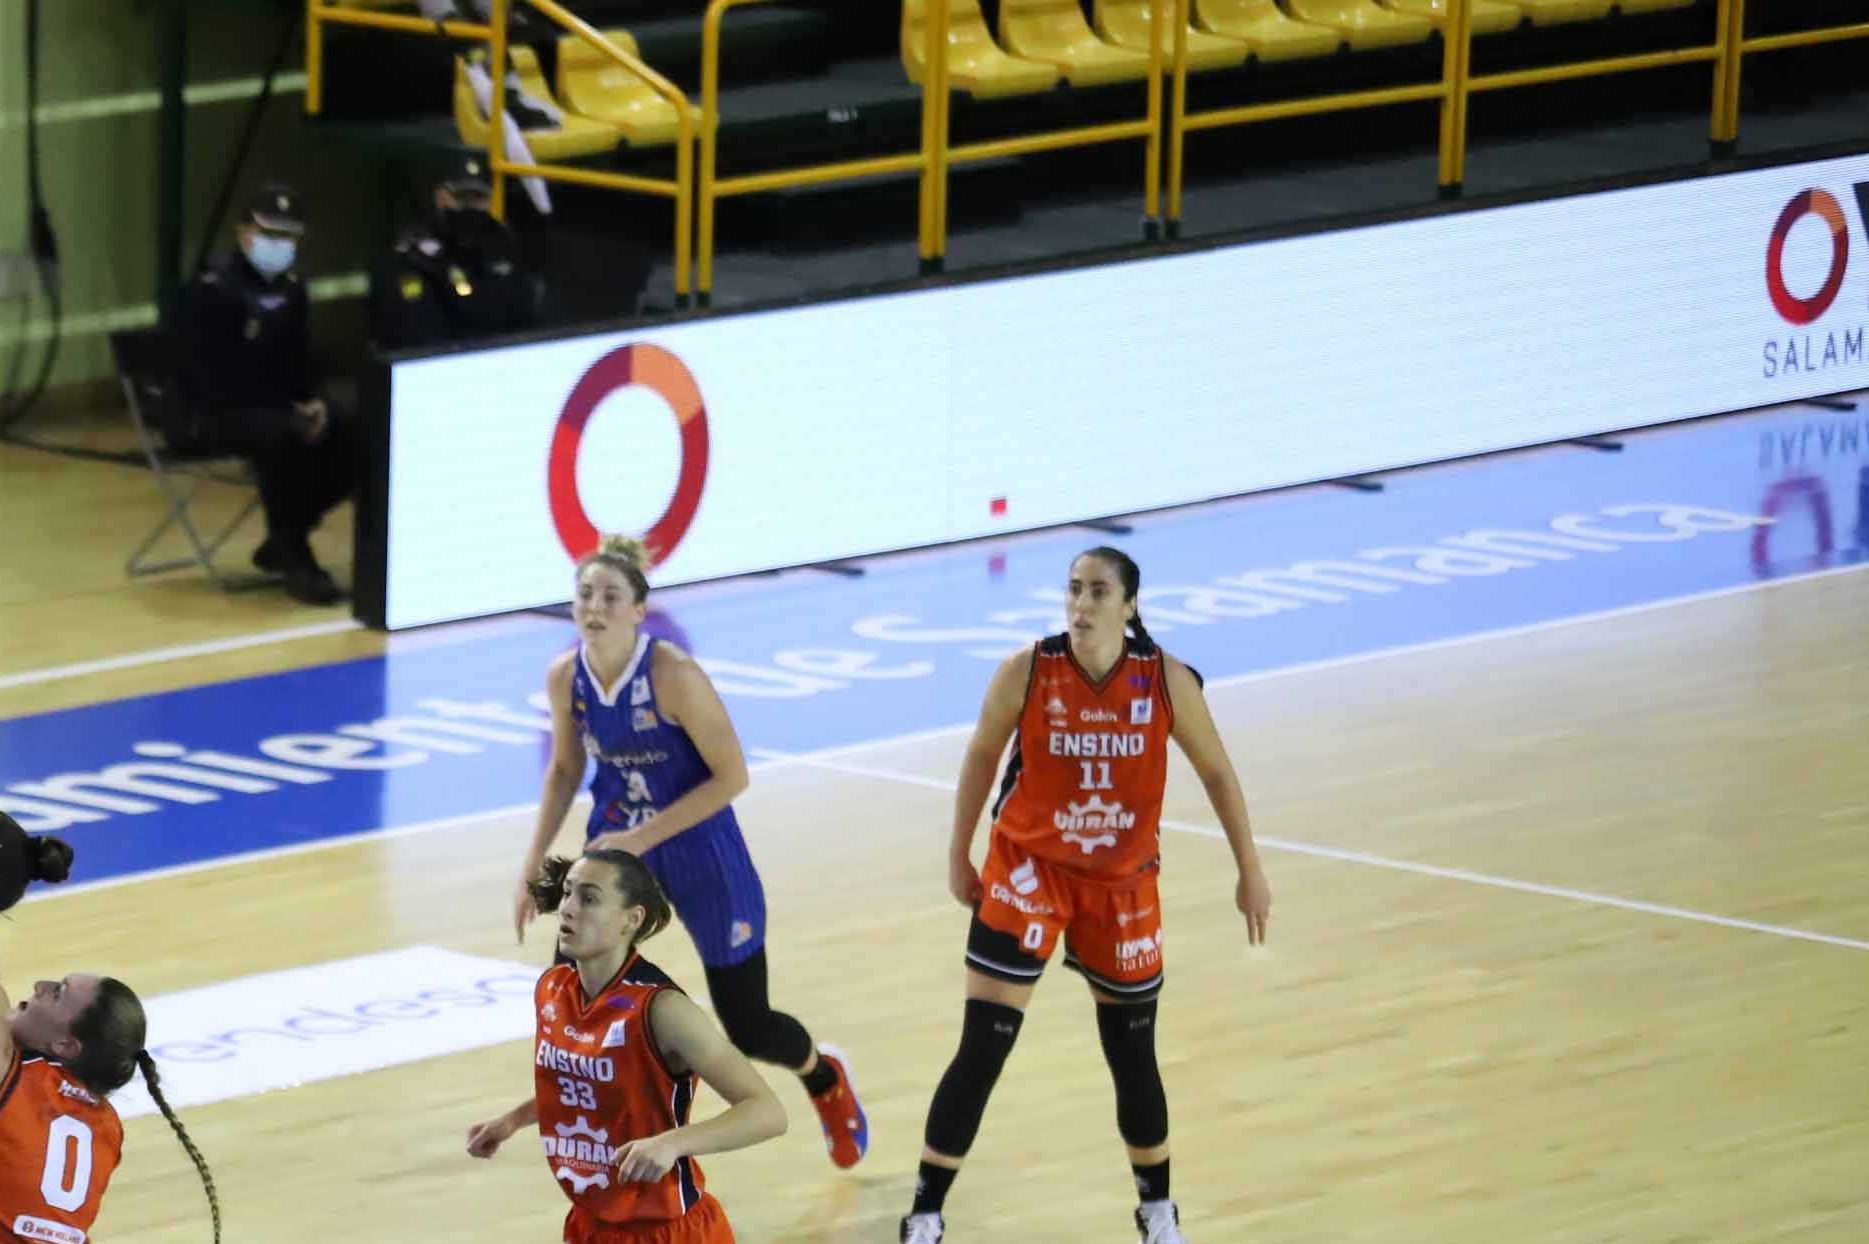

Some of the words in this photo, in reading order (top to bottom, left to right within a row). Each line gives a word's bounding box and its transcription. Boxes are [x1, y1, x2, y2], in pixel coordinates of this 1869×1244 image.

[1049, 731, 1145, 757] ENSINO
[1079, 760, 1114, 790] 11
[536, 1039, 615, 1083] ENSINO
[557, 1077, 598, 1111] 33
[39, 1113, 95, 1214] 0
